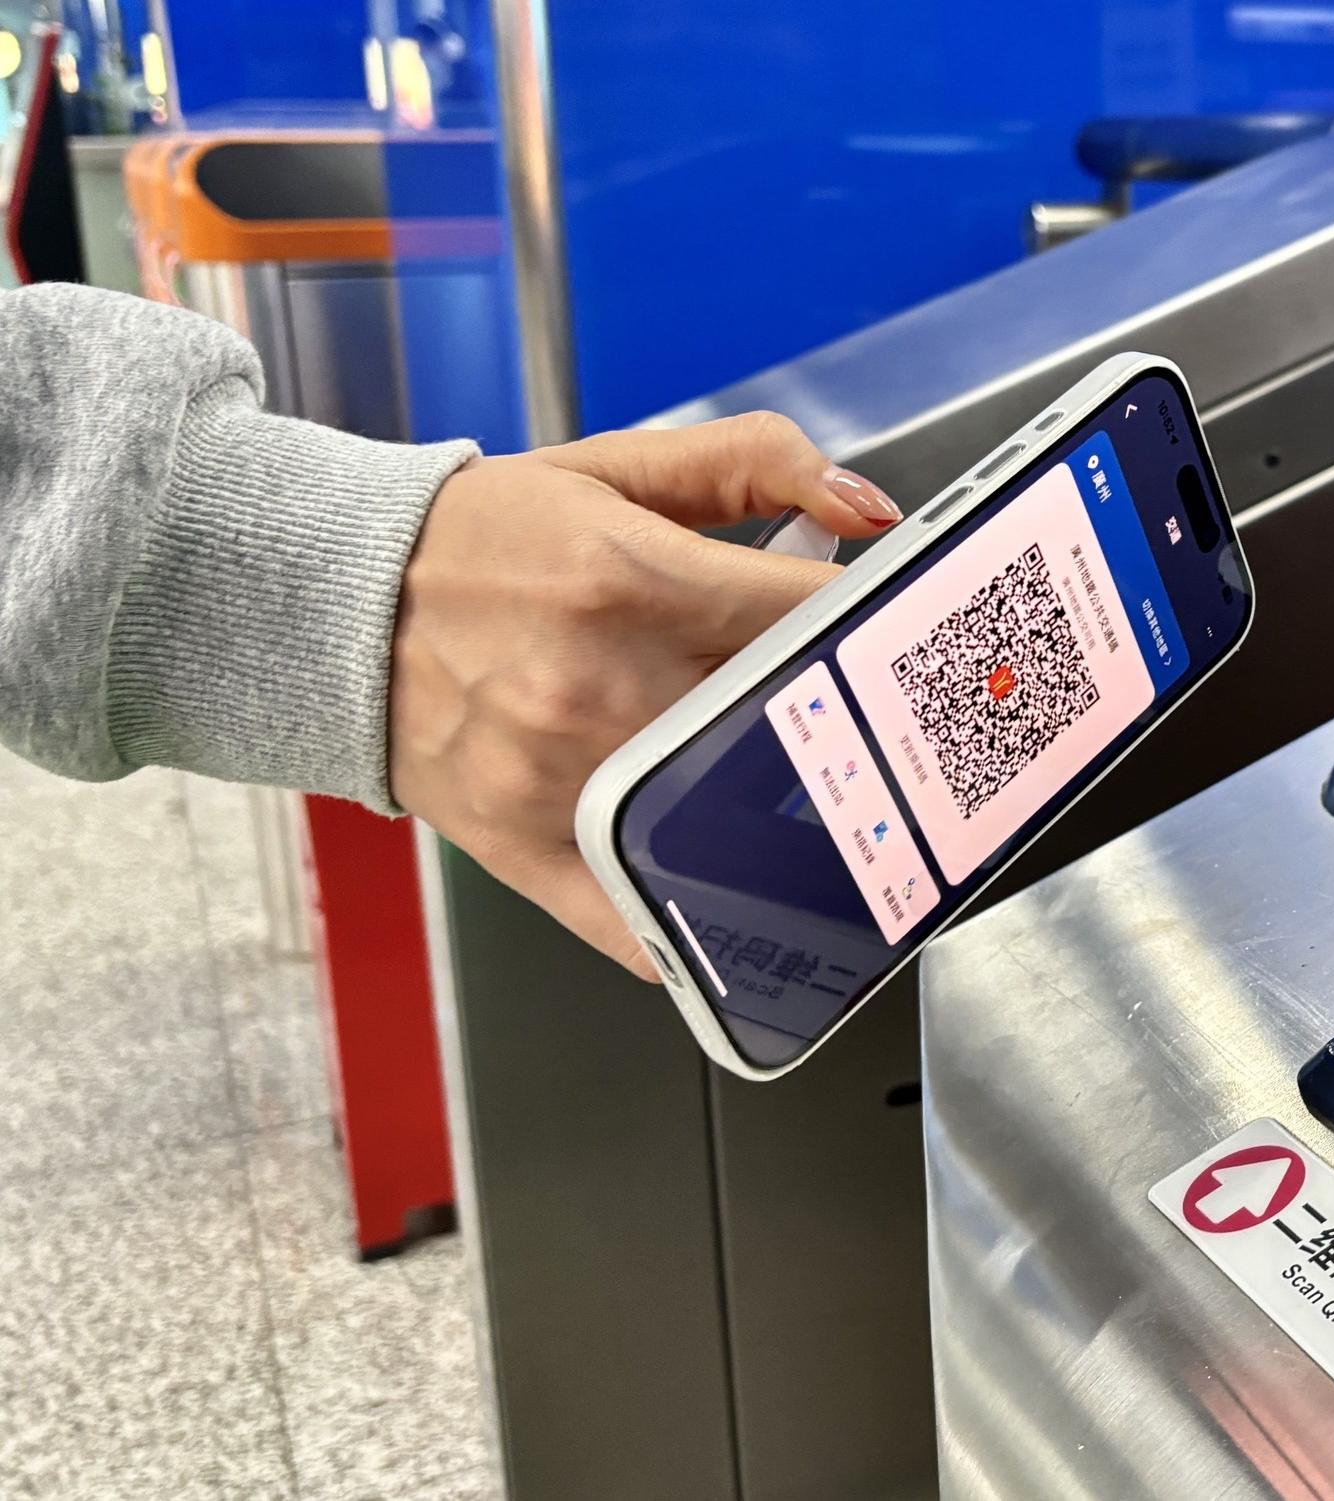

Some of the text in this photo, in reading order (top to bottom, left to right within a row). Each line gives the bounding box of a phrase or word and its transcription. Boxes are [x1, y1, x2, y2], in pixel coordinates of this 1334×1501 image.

[1091, 470, 1112, 503] 廣州
[1164, 515, 1184, 545] 交通
[1281, 1262, 1324, 1306] Scan
